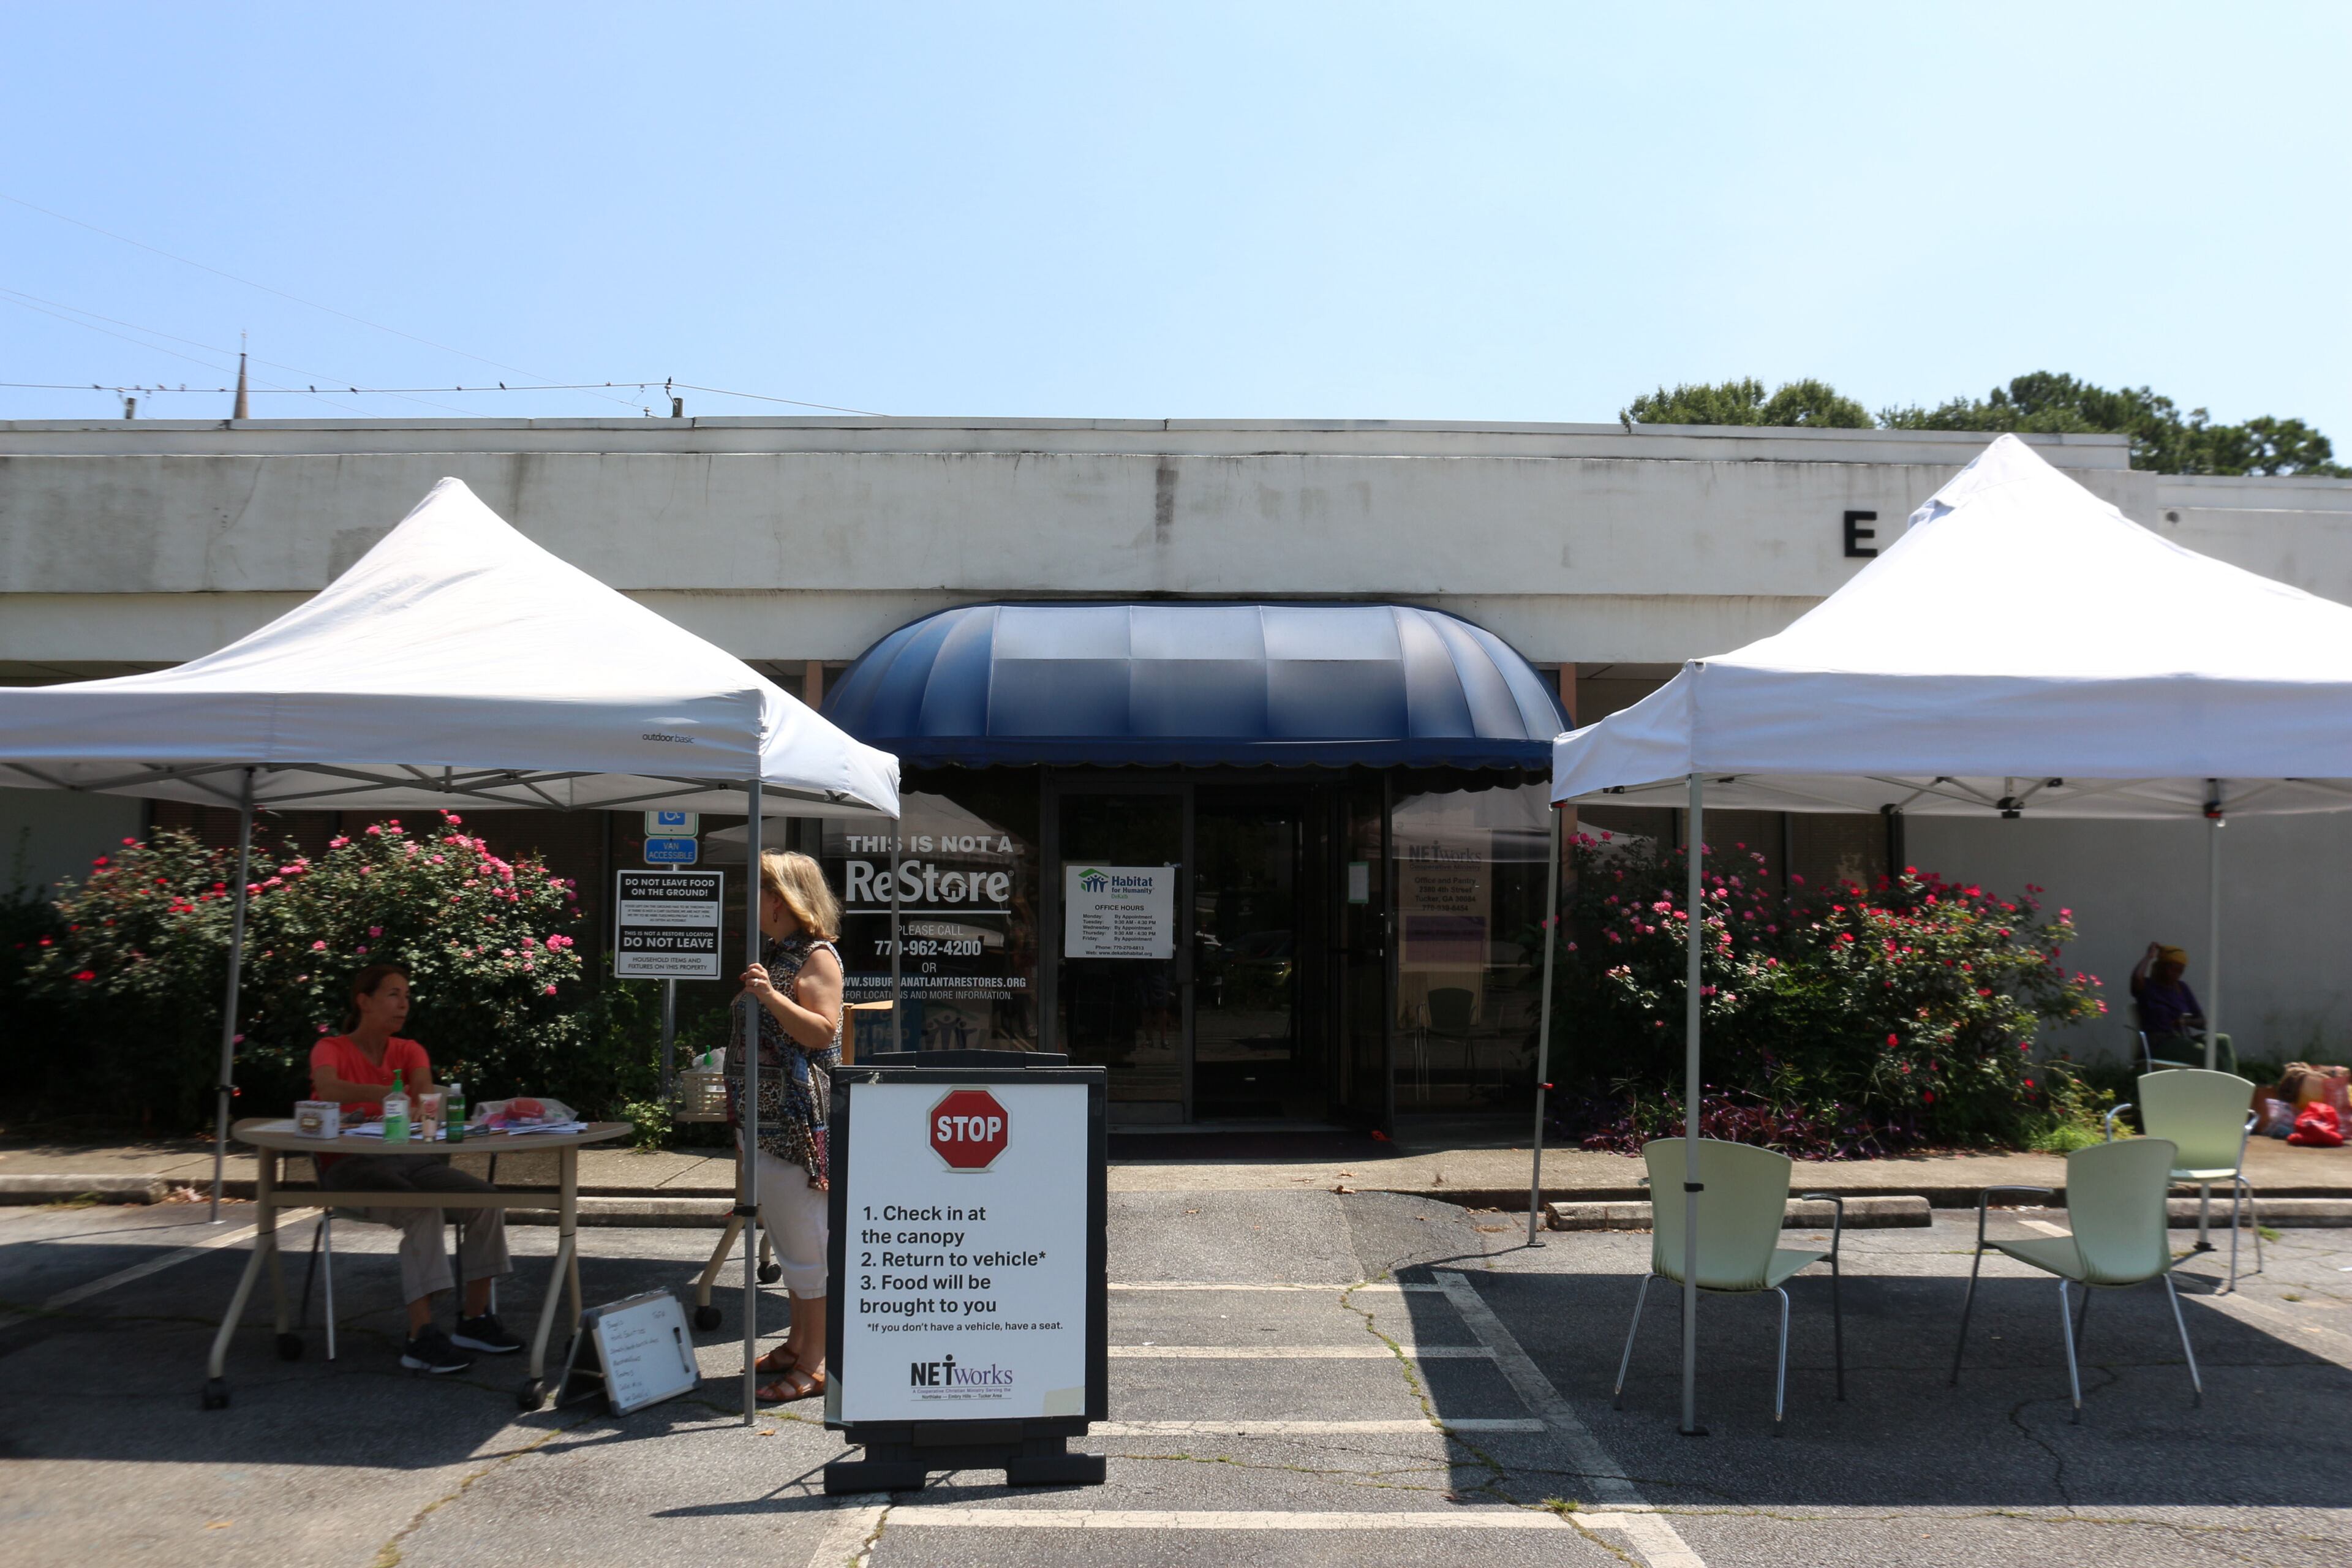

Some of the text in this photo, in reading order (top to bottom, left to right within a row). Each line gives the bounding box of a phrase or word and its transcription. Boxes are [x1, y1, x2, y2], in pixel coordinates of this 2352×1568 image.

[1843, 510, 1877, 557] E
[642, 733, 694, 744] outdoor basic
[846, 835, 1013, 853] THIS IS NOT A
[1112, 876, 1152, 886] Habitat
[937, 925, 963, 935] CALL
[624, 937, 713, 948] DO NOT LEAVE
[922, 962, 936, 973] OR
[845, 990, 1013, 1000] FOR LOCATINS AND MORE INFORMATION.
[937, 1115, 1001, 1142] STOP
[863, 1204, 986, 1221] 1. Check in at
[861, 1228, 964, 1247] the canopy
[861, 1252, 876, 1267] 2.
[882, 1250, 943, 1267] Return
[949, 1252, 967, 1267] to
[860, 1274, 990, 1290] 3. Food will be
[860, 1297, 996, 1317] brought to you
[881, 1324, 899, 1333] you
[930, 1322, 954, 1331] have
[965, 1322, 1002, 1331] vehicle,
[1005, 1321, 1028, 1330] have
[1039, 1321, 1063, 1330] seat.
